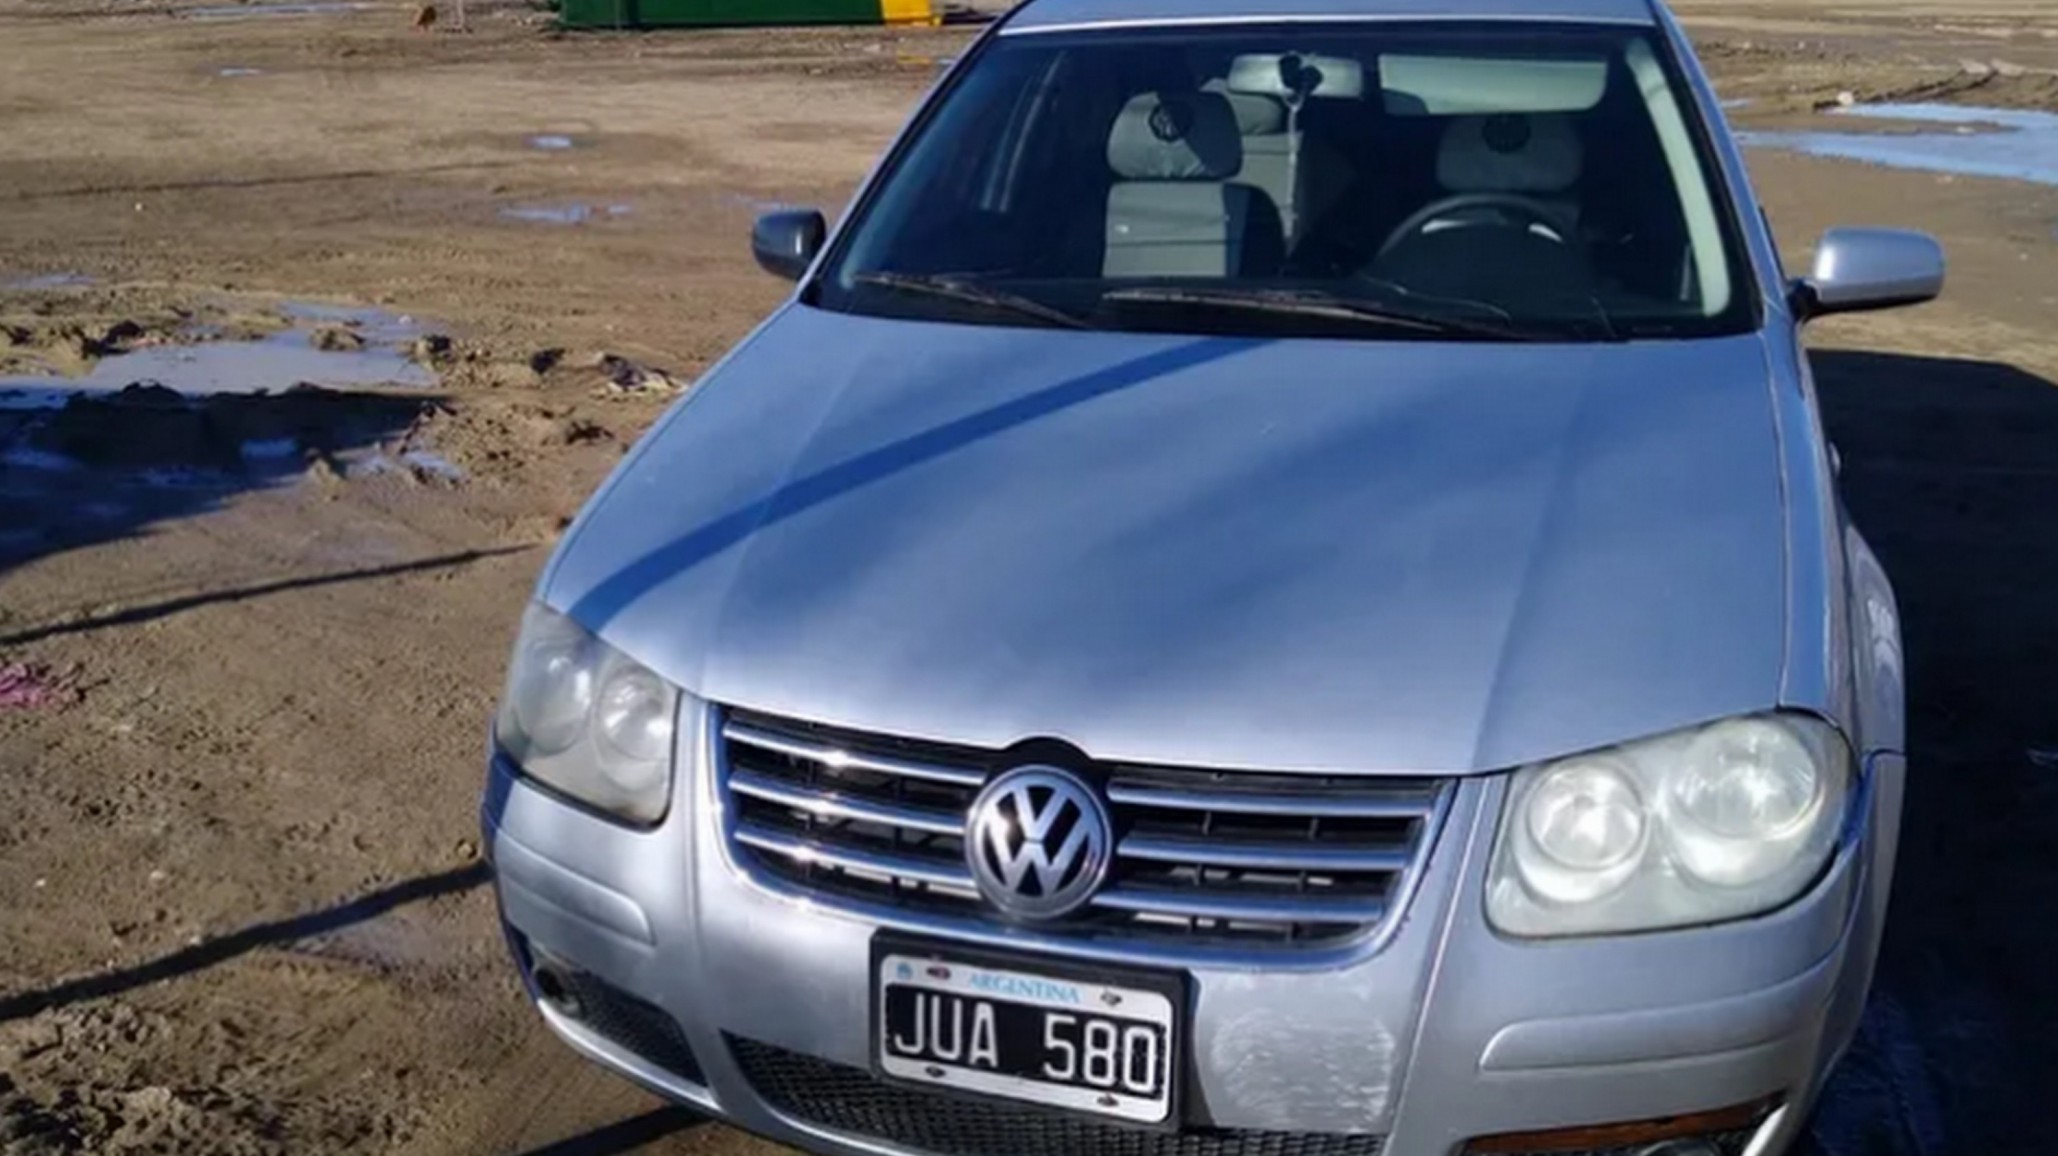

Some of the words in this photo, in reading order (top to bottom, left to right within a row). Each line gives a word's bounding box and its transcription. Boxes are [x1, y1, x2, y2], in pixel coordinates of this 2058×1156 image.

[974, 773, 1101, 908] VW
[968, 972, 1081, 1004] ARGENTINA
[894, 992, 998, 1068] JUA
[1043, 1012, 1156, 1093] 580
